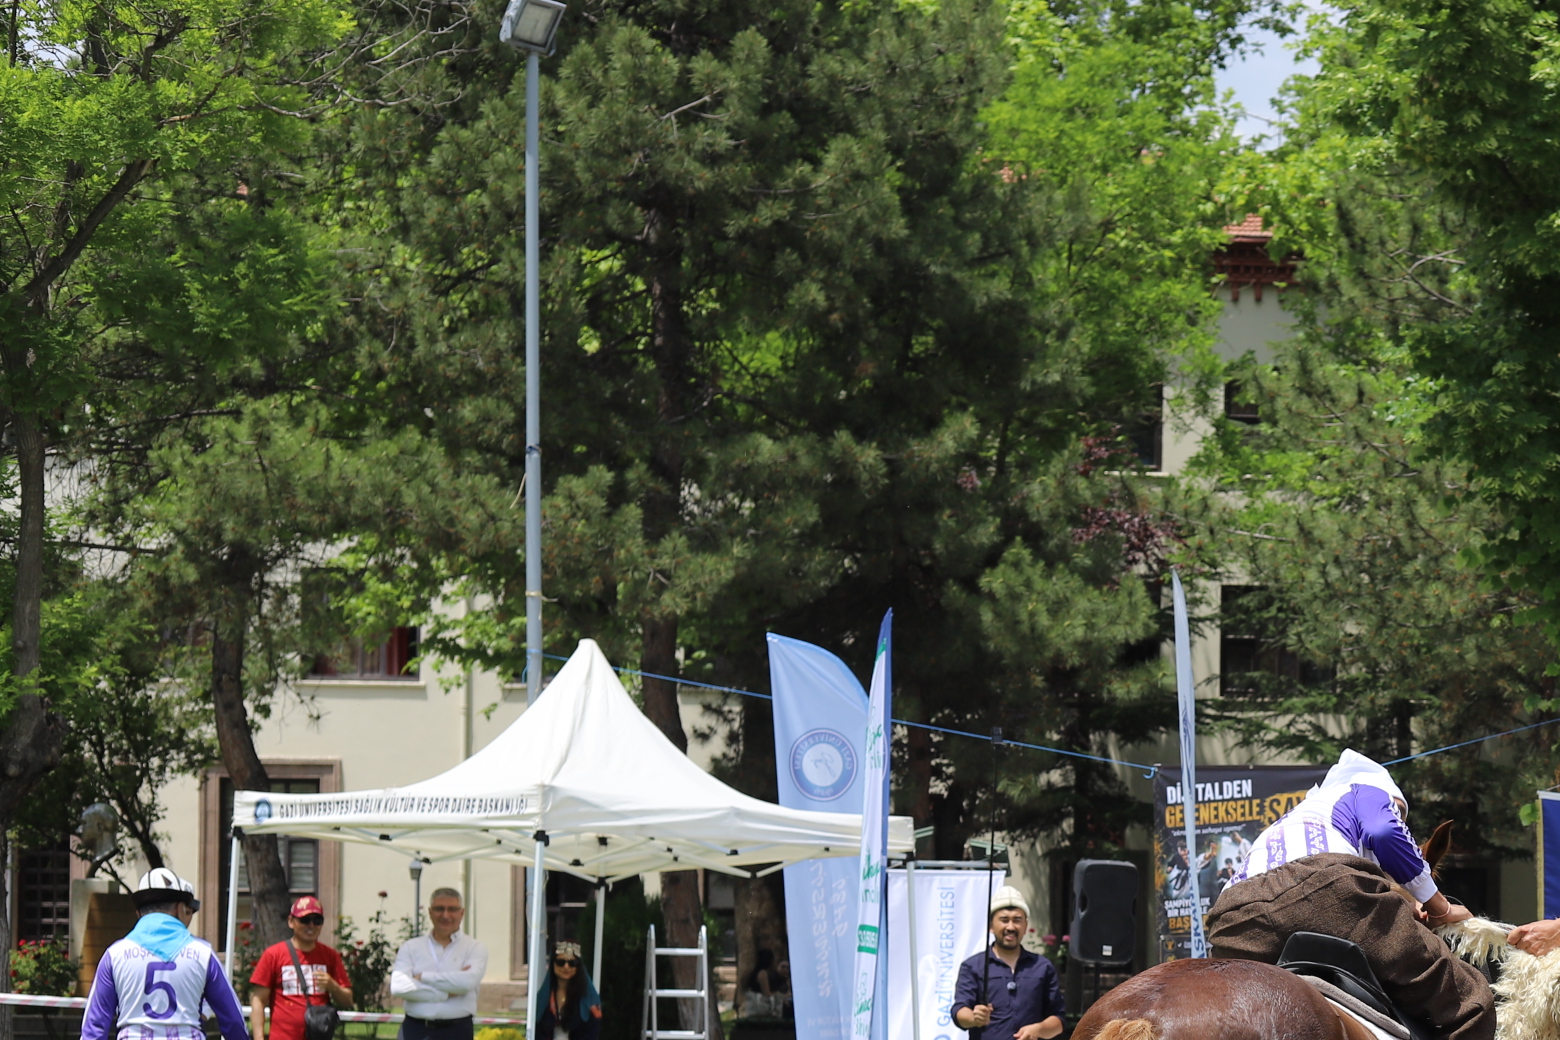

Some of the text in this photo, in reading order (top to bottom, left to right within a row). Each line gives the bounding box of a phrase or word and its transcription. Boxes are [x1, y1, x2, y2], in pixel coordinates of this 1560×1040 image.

[1166, 779, 1253, 805] DİTALDEN
[279, 799, 298, 819] GAZİ
[299, 798, 352, 817] ÜNİVERSİTESİ
[353, 795, 382, 814] SAĞLIK
[384, 793, 414, 814] KÜLTÜR
[416, 797, 427, 814] VE
[428, 797, 449, 814] SPOR
[451, 795, 476, 814] DAİRE
[1165, 799, 1265, 828] GEENEKSELE,
[180, 948, 200, 961] VEN
[143, 961, 178, 1020] 5
